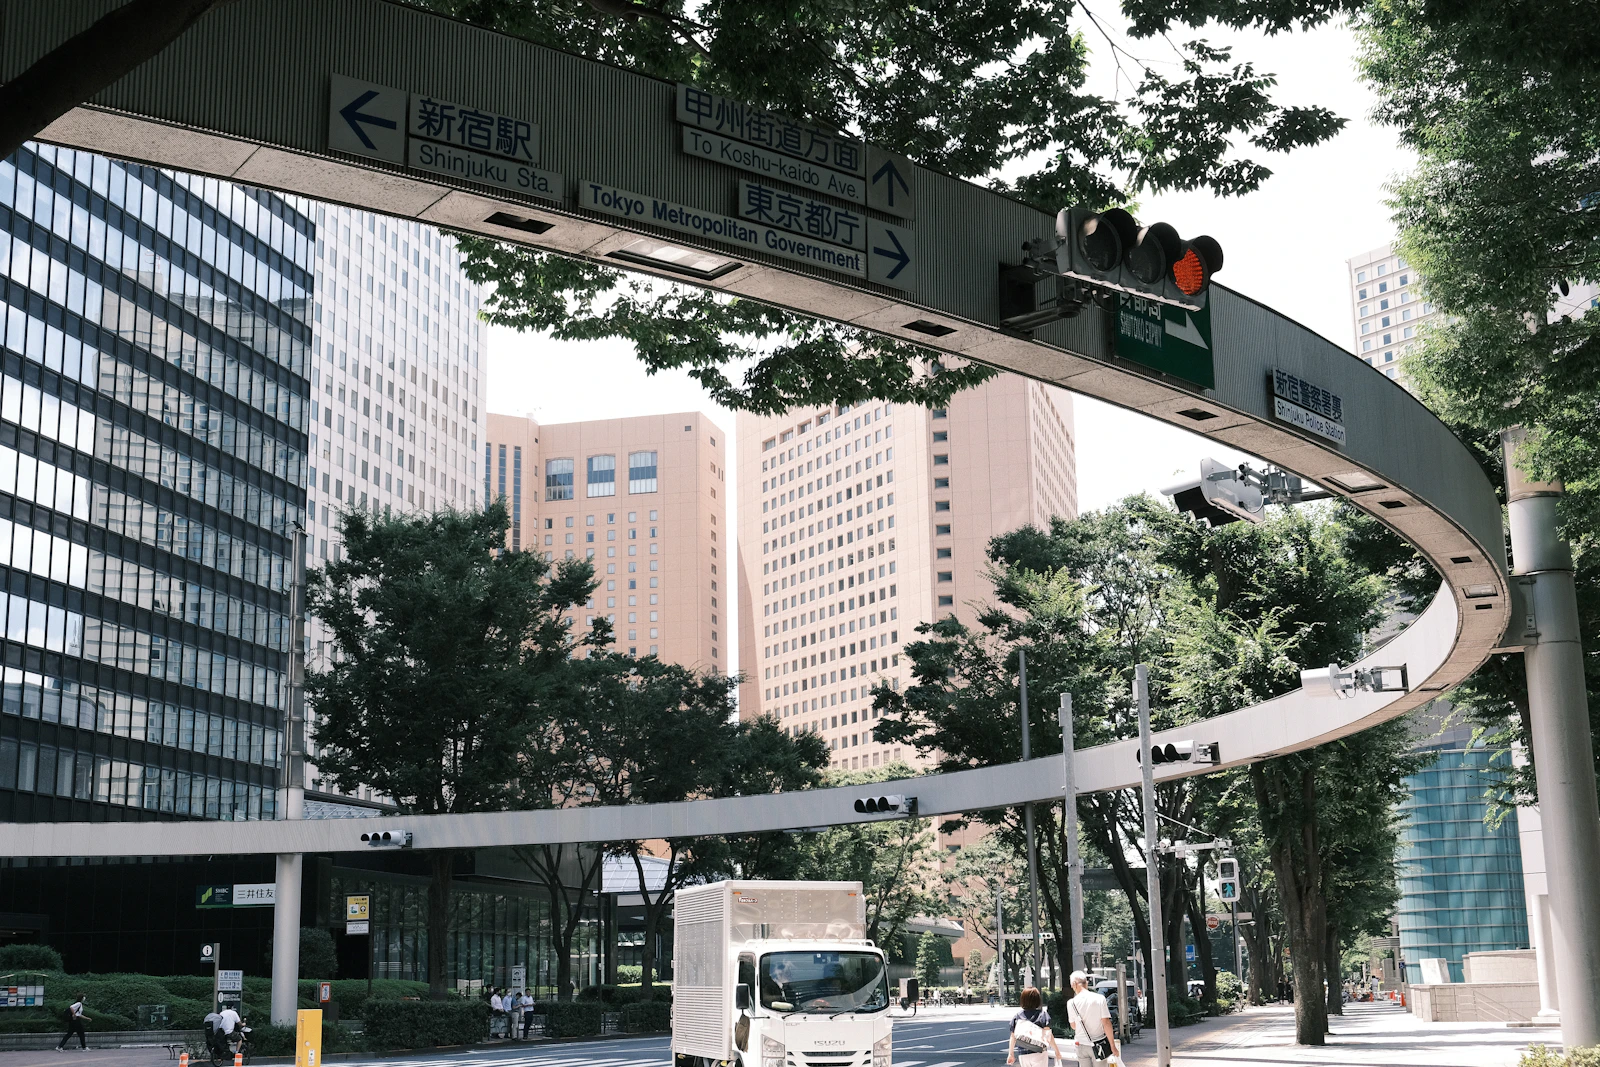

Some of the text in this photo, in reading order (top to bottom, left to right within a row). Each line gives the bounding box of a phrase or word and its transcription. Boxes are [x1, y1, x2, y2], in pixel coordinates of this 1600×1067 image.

[417, 97, 533, 160] 新宿駅
[685, 88, 859, 172] 甲州街道方面
[419, 144, 554, 193] Shinjuku Sta.
[690, 132, 859, 199] To Koshu-kaido Ave.
[589, 184, 861, 271] Tokyo Metropolitan Government
[745, 183, 860, 246] 東京都庁
[1275, 368, 1343, 423] 新宿警察署裏
[1277, 400, 1345, 442] Shinjuku Police Station
[237, 888, 276, 899] 三井住友
